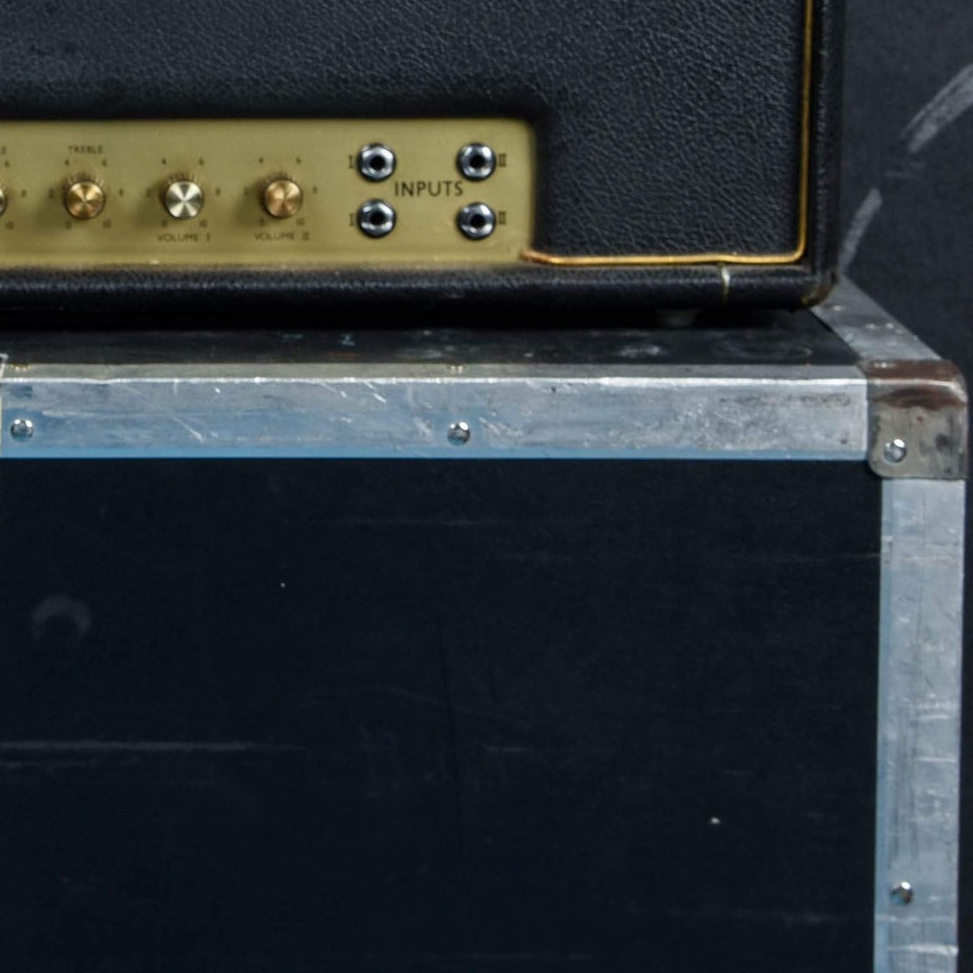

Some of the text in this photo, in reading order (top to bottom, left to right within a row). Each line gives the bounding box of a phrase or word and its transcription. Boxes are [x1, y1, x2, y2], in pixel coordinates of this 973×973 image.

[67, 144, 103, 155] TREBLE
[394, 180, 464, 197] INPUTS
[156, 232, 199, 242] VOLUME
[254, 231, 296, 241] VOLUME
